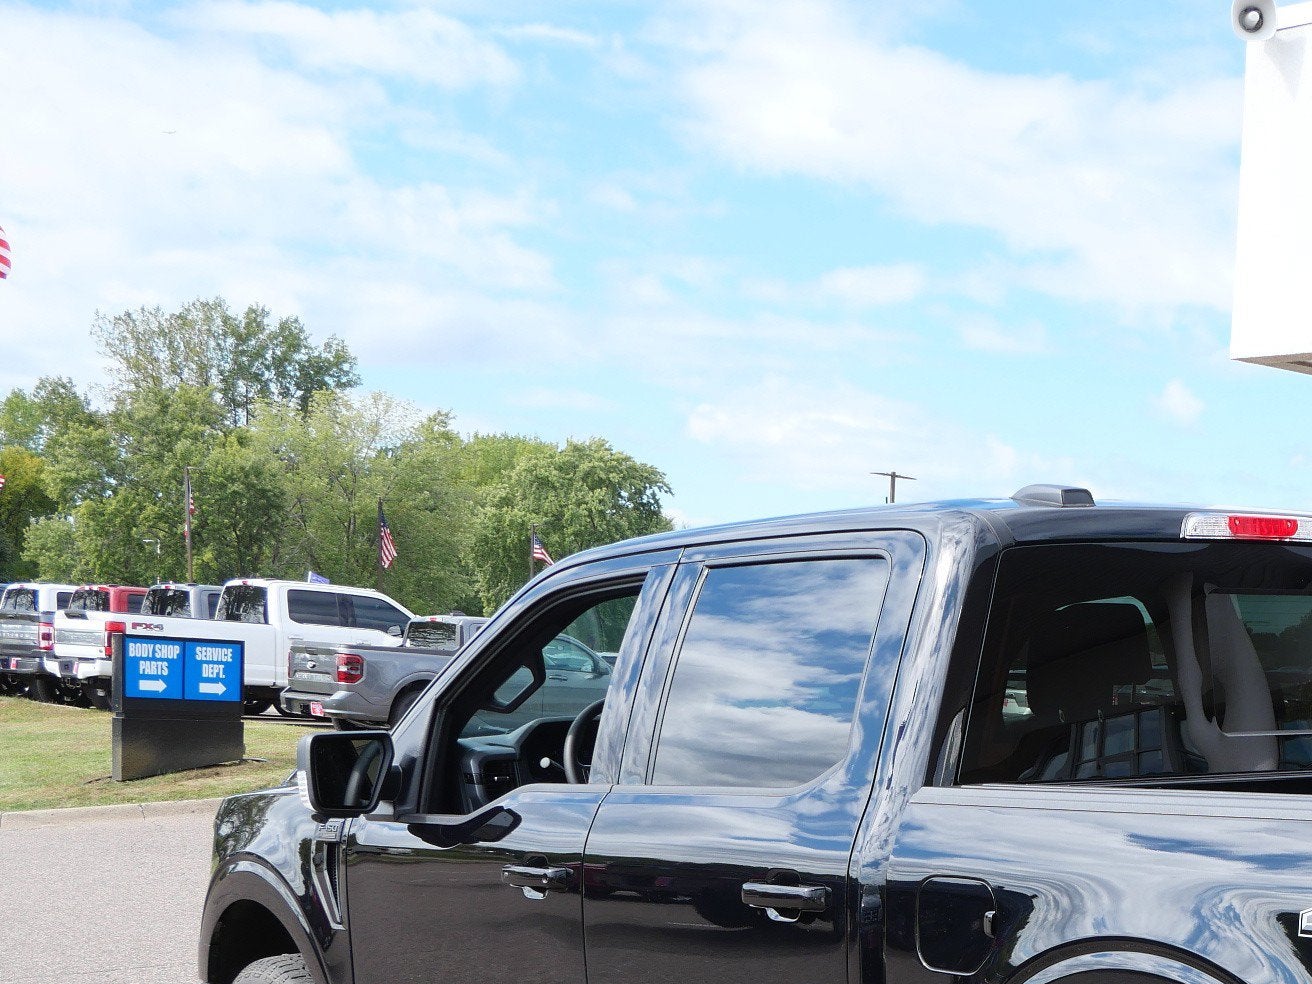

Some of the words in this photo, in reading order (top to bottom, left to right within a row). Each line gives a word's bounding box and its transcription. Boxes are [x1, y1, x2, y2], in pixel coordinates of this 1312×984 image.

[131, 622, 164, 632] FX4
[128, 642, 154, 658] BODY
[155, 644, 180, 660] SHOP
[195, 646, 233, 662] SERVICE
[139, 660, 169, 676] PARTS
[201, 663, 226, 679] DEPT.
